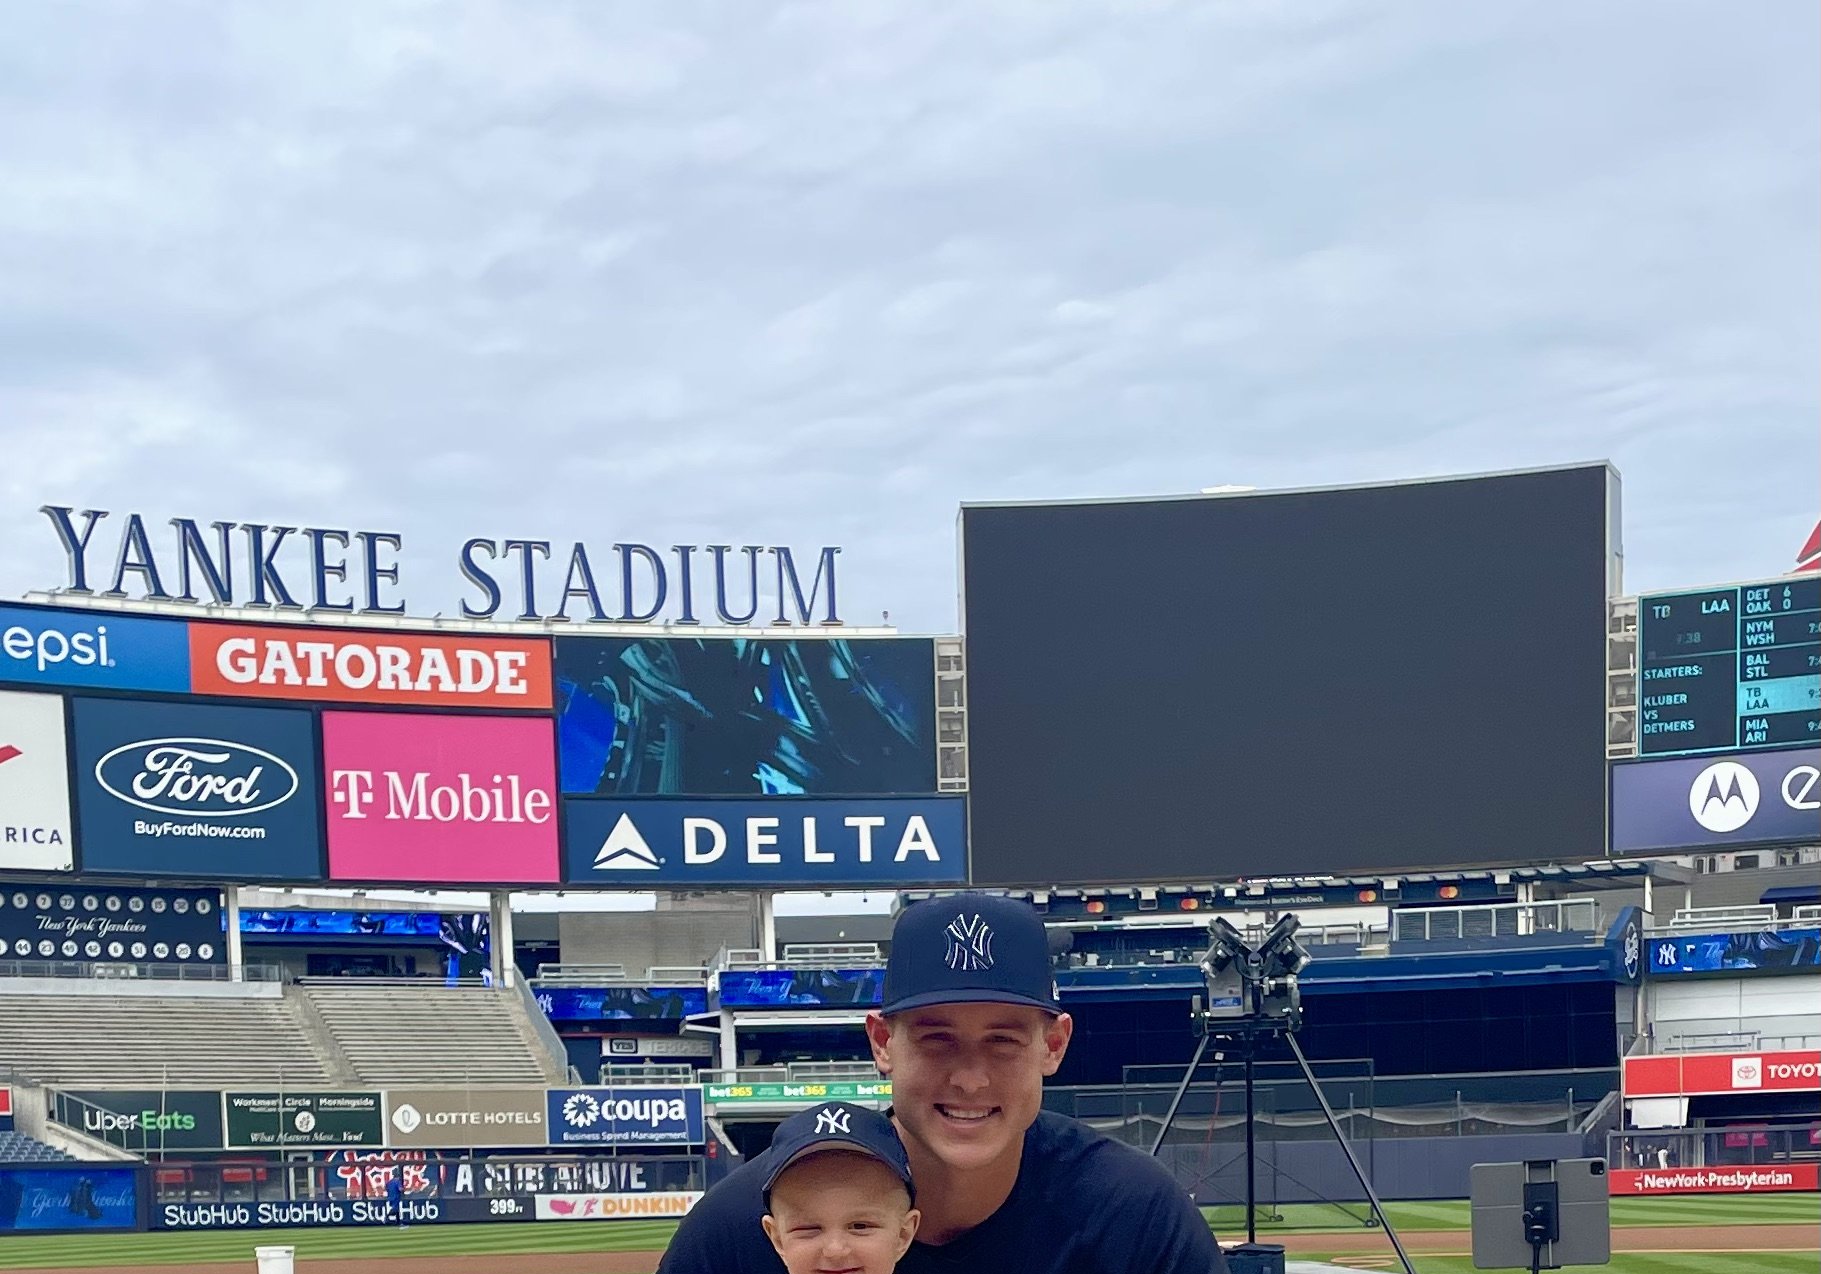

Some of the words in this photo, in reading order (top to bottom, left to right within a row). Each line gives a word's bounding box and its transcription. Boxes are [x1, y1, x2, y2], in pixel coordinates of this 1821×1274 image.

[40, 505, 405, 615] YANKEE
[459, 538, 843, 626] STADIUM
[1747, 588, 1770, 601] DET
[1783, 586, 1791, 597] 6
[1701, 599, 1730, 614] LAA
[1747, 600, 1771, 613] OAK
[1783, 599, 1791, 610] 0
[1746, 620, 1773, 634] NYM
[1746, 633, 1775, 646] WSH
[216, 637, 528, 694] GATORADE
[1746, 654, 1770, 667] BAL
[1644, 665, 1703, 680] STARTERS:
[1746, 666, 1769, 678] STL
[1746, 687, 1762, 698] TB
[1643, 693, 1688, 708] KLUBER
[1746, 698, 1770, 711] LAA
[1643, 709, 1658, 720] VS
[1643, 720, 1695, 734] DETMERS
[1745, 718, 1769, 731] MIA
[1745, 731, 1767, 743] ARI
[132, 747, 264, 804] Ford
[385, 772, 551, 823] Mobile
[5, 826, 63, 845] RICA
[134, 820, 266, 839] BuyFordNow.com
[683, 815, 941, 864] DELTA
[35, 915, 65, 930] New
[65, 917, 95, 937] York
[95, 917, 147, 938] Yankees
[709, 1085, 753, 1097] bet365
[783, 1085, 827, 1097] bet365
[85, 1110, 138, 1130] Uber
[141, 1110, 195, 1130] Eats
[426, 1112, 481, 1125] LOTTE
[484, 1111, 542, 1124] HOTELS
[601, 1098, 686, 1128] coupa
[814, 1107, 851, 1134] NY
[563, 1131, 600, 1141] Business
[601, 1131, 630, 1142] Spend
[630, 1130, 688, 1142] Management
[257, 1202, 343, 1224] StubHub
[602, 1196, 692, 1216] DUNKIN'
[164, 1203, 250, 1226] StubHub
